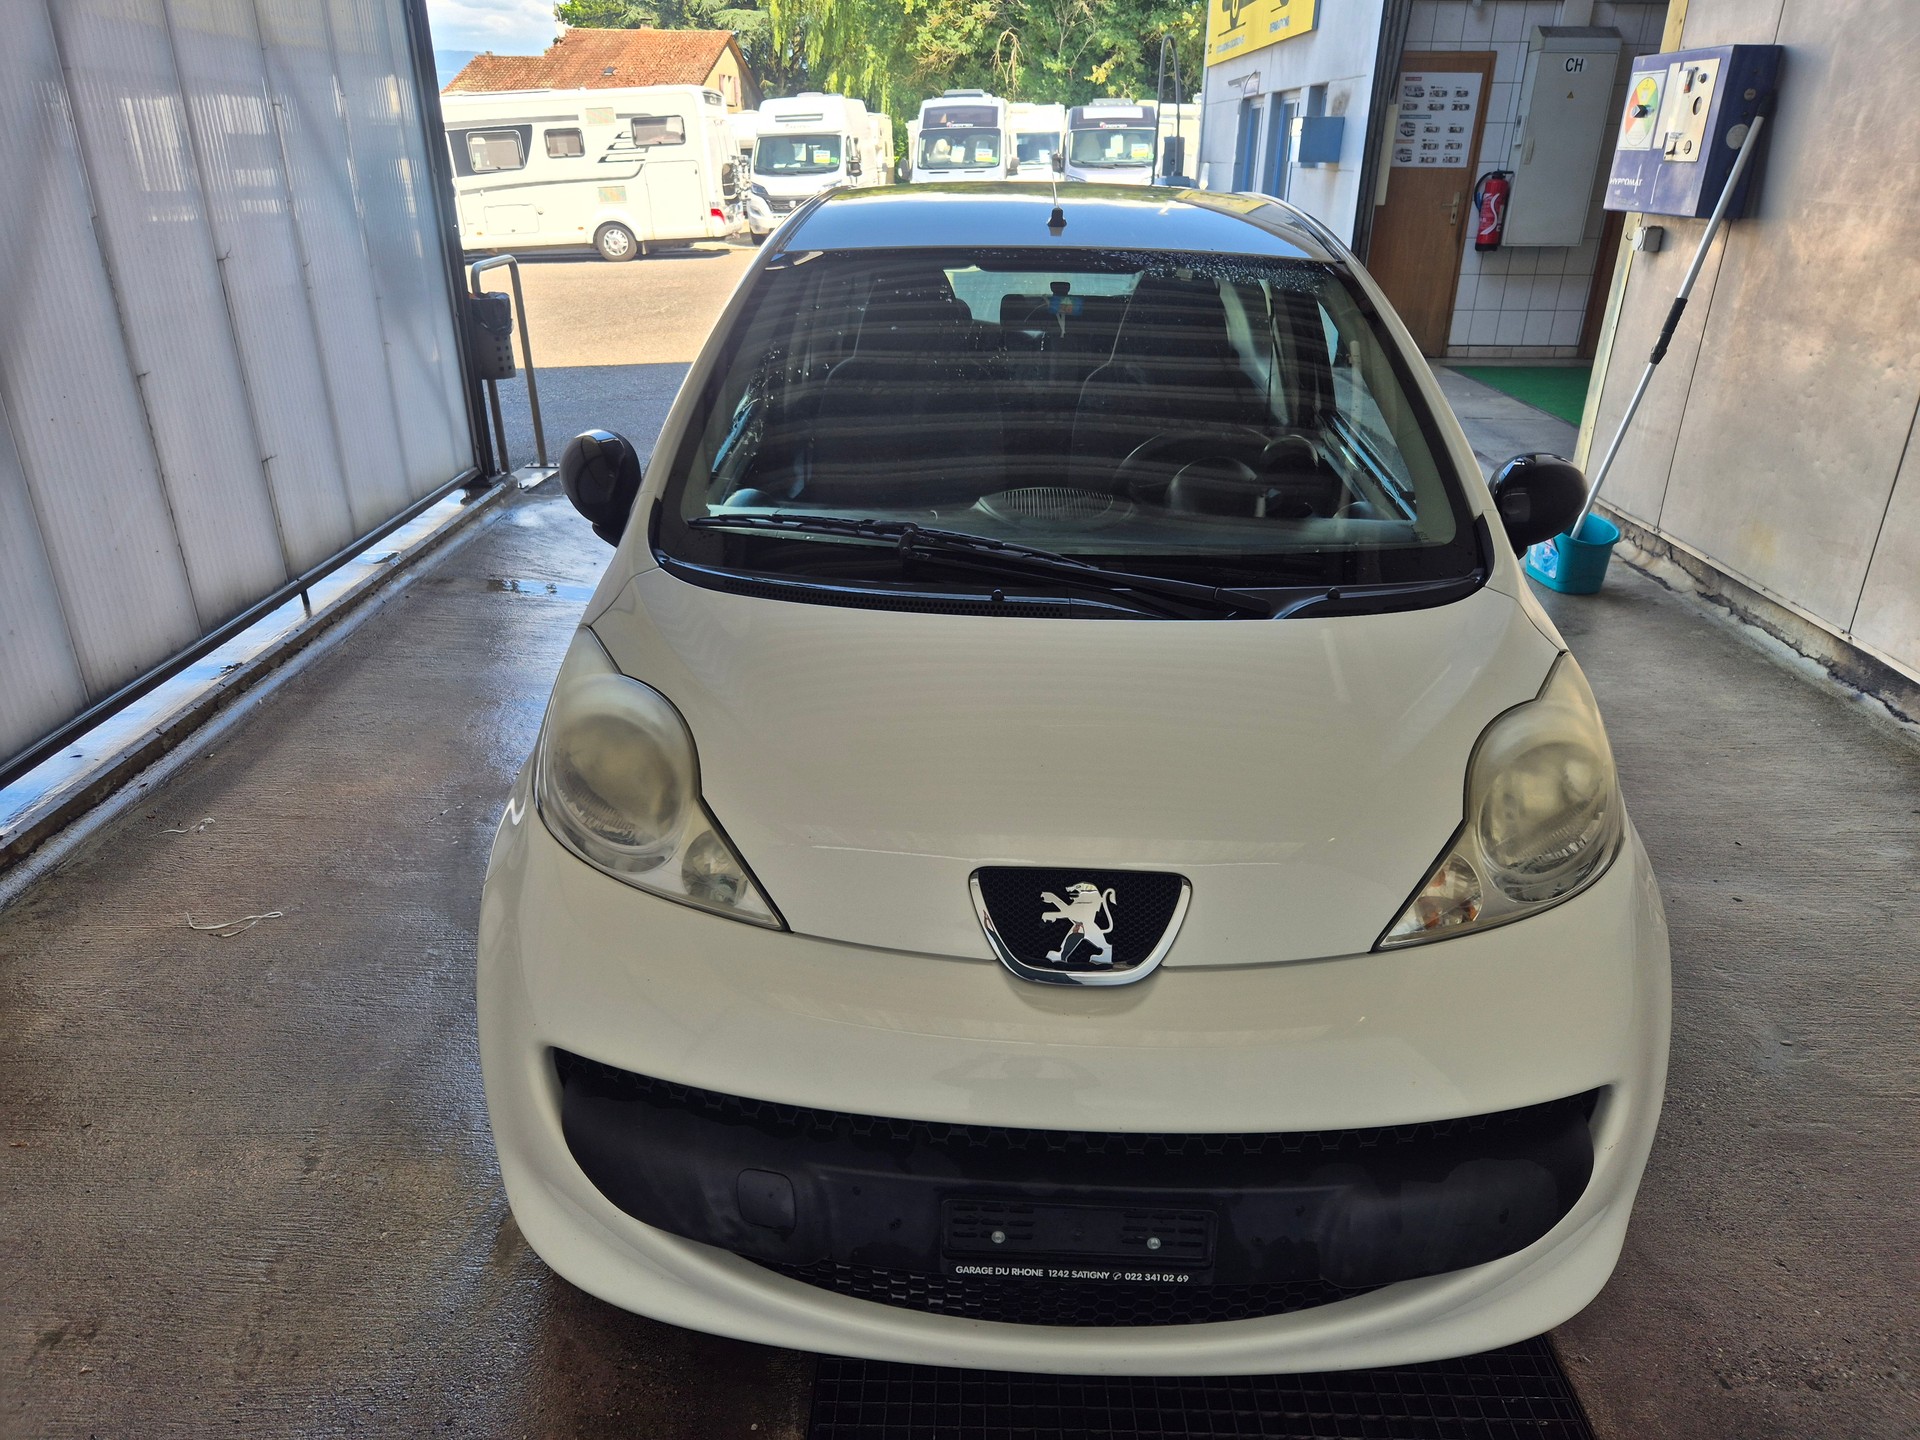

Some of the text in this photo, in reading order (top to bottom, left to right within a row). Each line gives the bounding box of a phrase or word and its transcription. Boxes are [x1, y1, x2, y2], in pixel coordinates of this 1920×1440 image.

[1565, 57, 1584, 73] CH
[955, 1265, 1190, 1283] GARAGE DU RHONE 1242 SATIGNY 022 341 02 69
